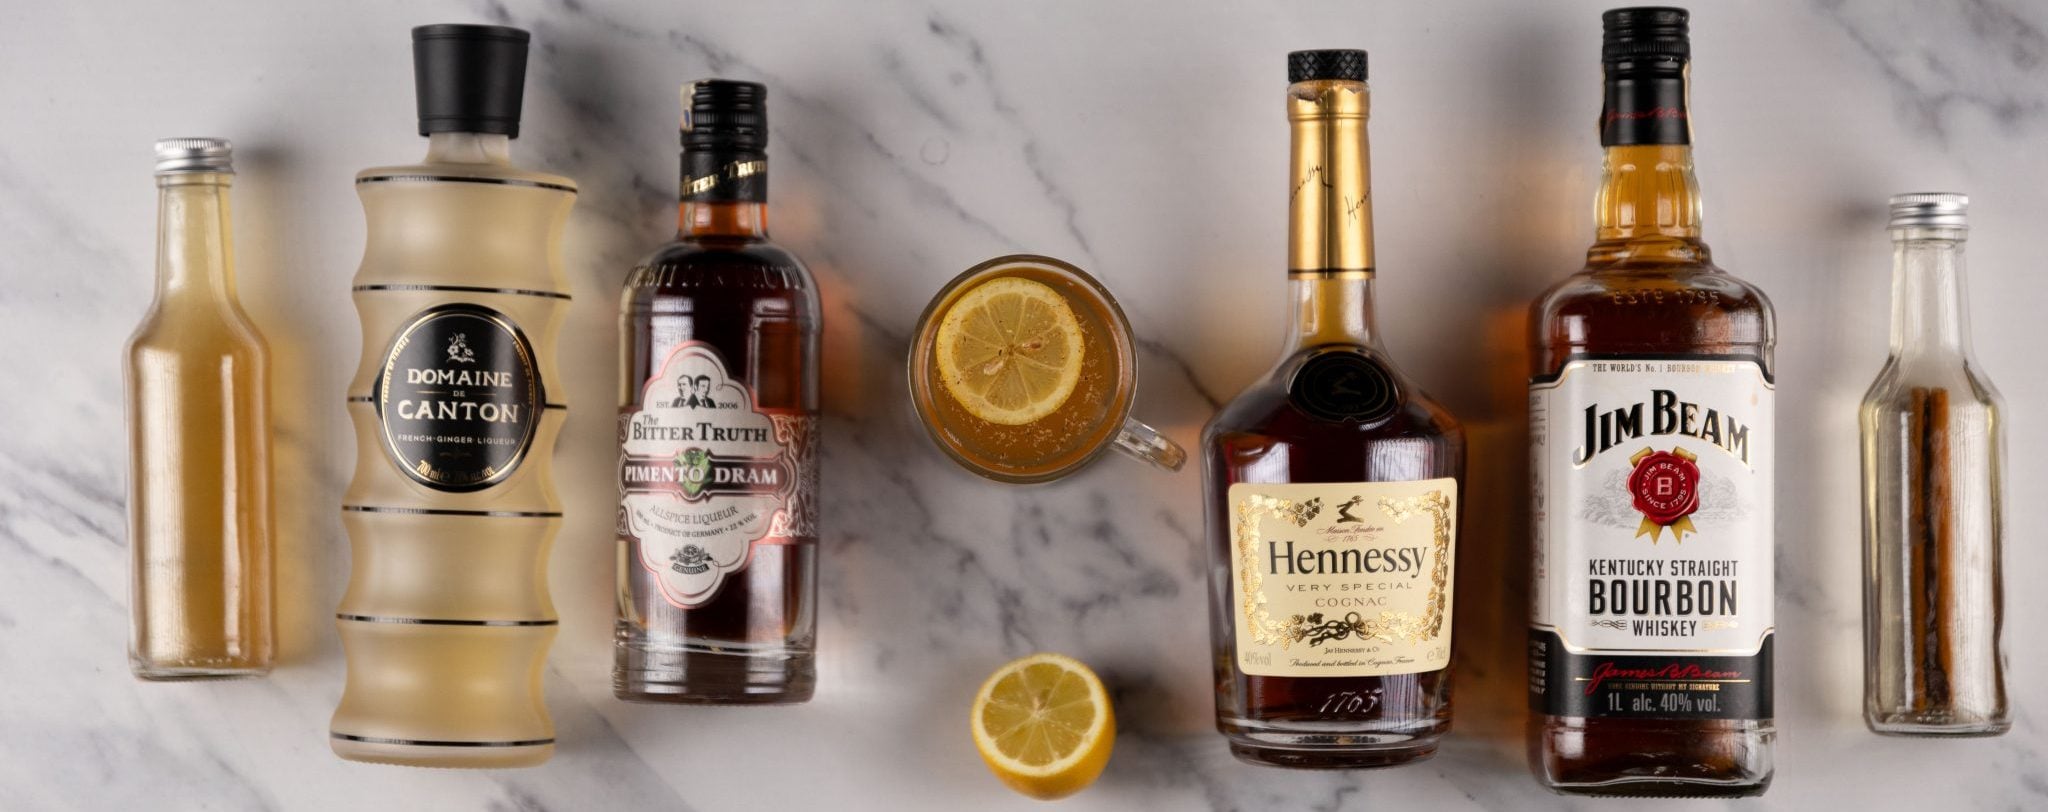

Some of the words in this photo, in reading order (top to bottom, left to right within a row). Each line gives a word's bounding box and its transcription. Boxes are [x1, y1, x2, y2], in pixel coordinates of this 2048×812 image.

[407, 368, 513, 388] DOMAINE
[1593, 363, 1607, 373] THE
[1610, 363, 1641, 373] WORLD'S
[397, 400, 519, 423] CANTON
[643, 414, 659, 425] The
[633, 422, 694, 441] BITTER
[696, 422, 768, 442] TRUTH
[1572, 402, 1645, 470] JIM
[1650, 389, 1751, 466] BEAM
[477, 437, 516, 445] LIQUEUR
[625, 465, 704, 484] PIMENTO
[714, 466, 778, 485] DRAM
[1644, 466, 1657, 480] JIM
[1660, 463, 1686, 481] BEAM
[1657, 477, 1673, 495] B
[1642, 489, 1667, 509] SINCE
[1670, 489, 1687, 508] 1795
[692, 506, 739, 526] LIQUEUR
[1268, 541, 1429, 579] Hennessy
[1589, 559, 1665, 576] KENTUCKY
[1671, 560, 1739, 577] STRAIGHT
[1286, 584, 1332, 592] VERY
[1341, 582, 1413, 591] SPECIAL
[1315, 596, 1388, 608] COGNAC
[1589, 579, 1738, 616] BOURBON
[1633, 620, 1697, 637] WHISKEY
[1689, 683, 1720, 691] SIGNATURE
[1319, 688, 1383, 713] 1765
[1608, 692, 1623, 711] 1L
[1632, 693, 1657, 712] alc.
[1660, 693, 1692, 712] 40%
[1697, 694, 1721, 712] vol.
